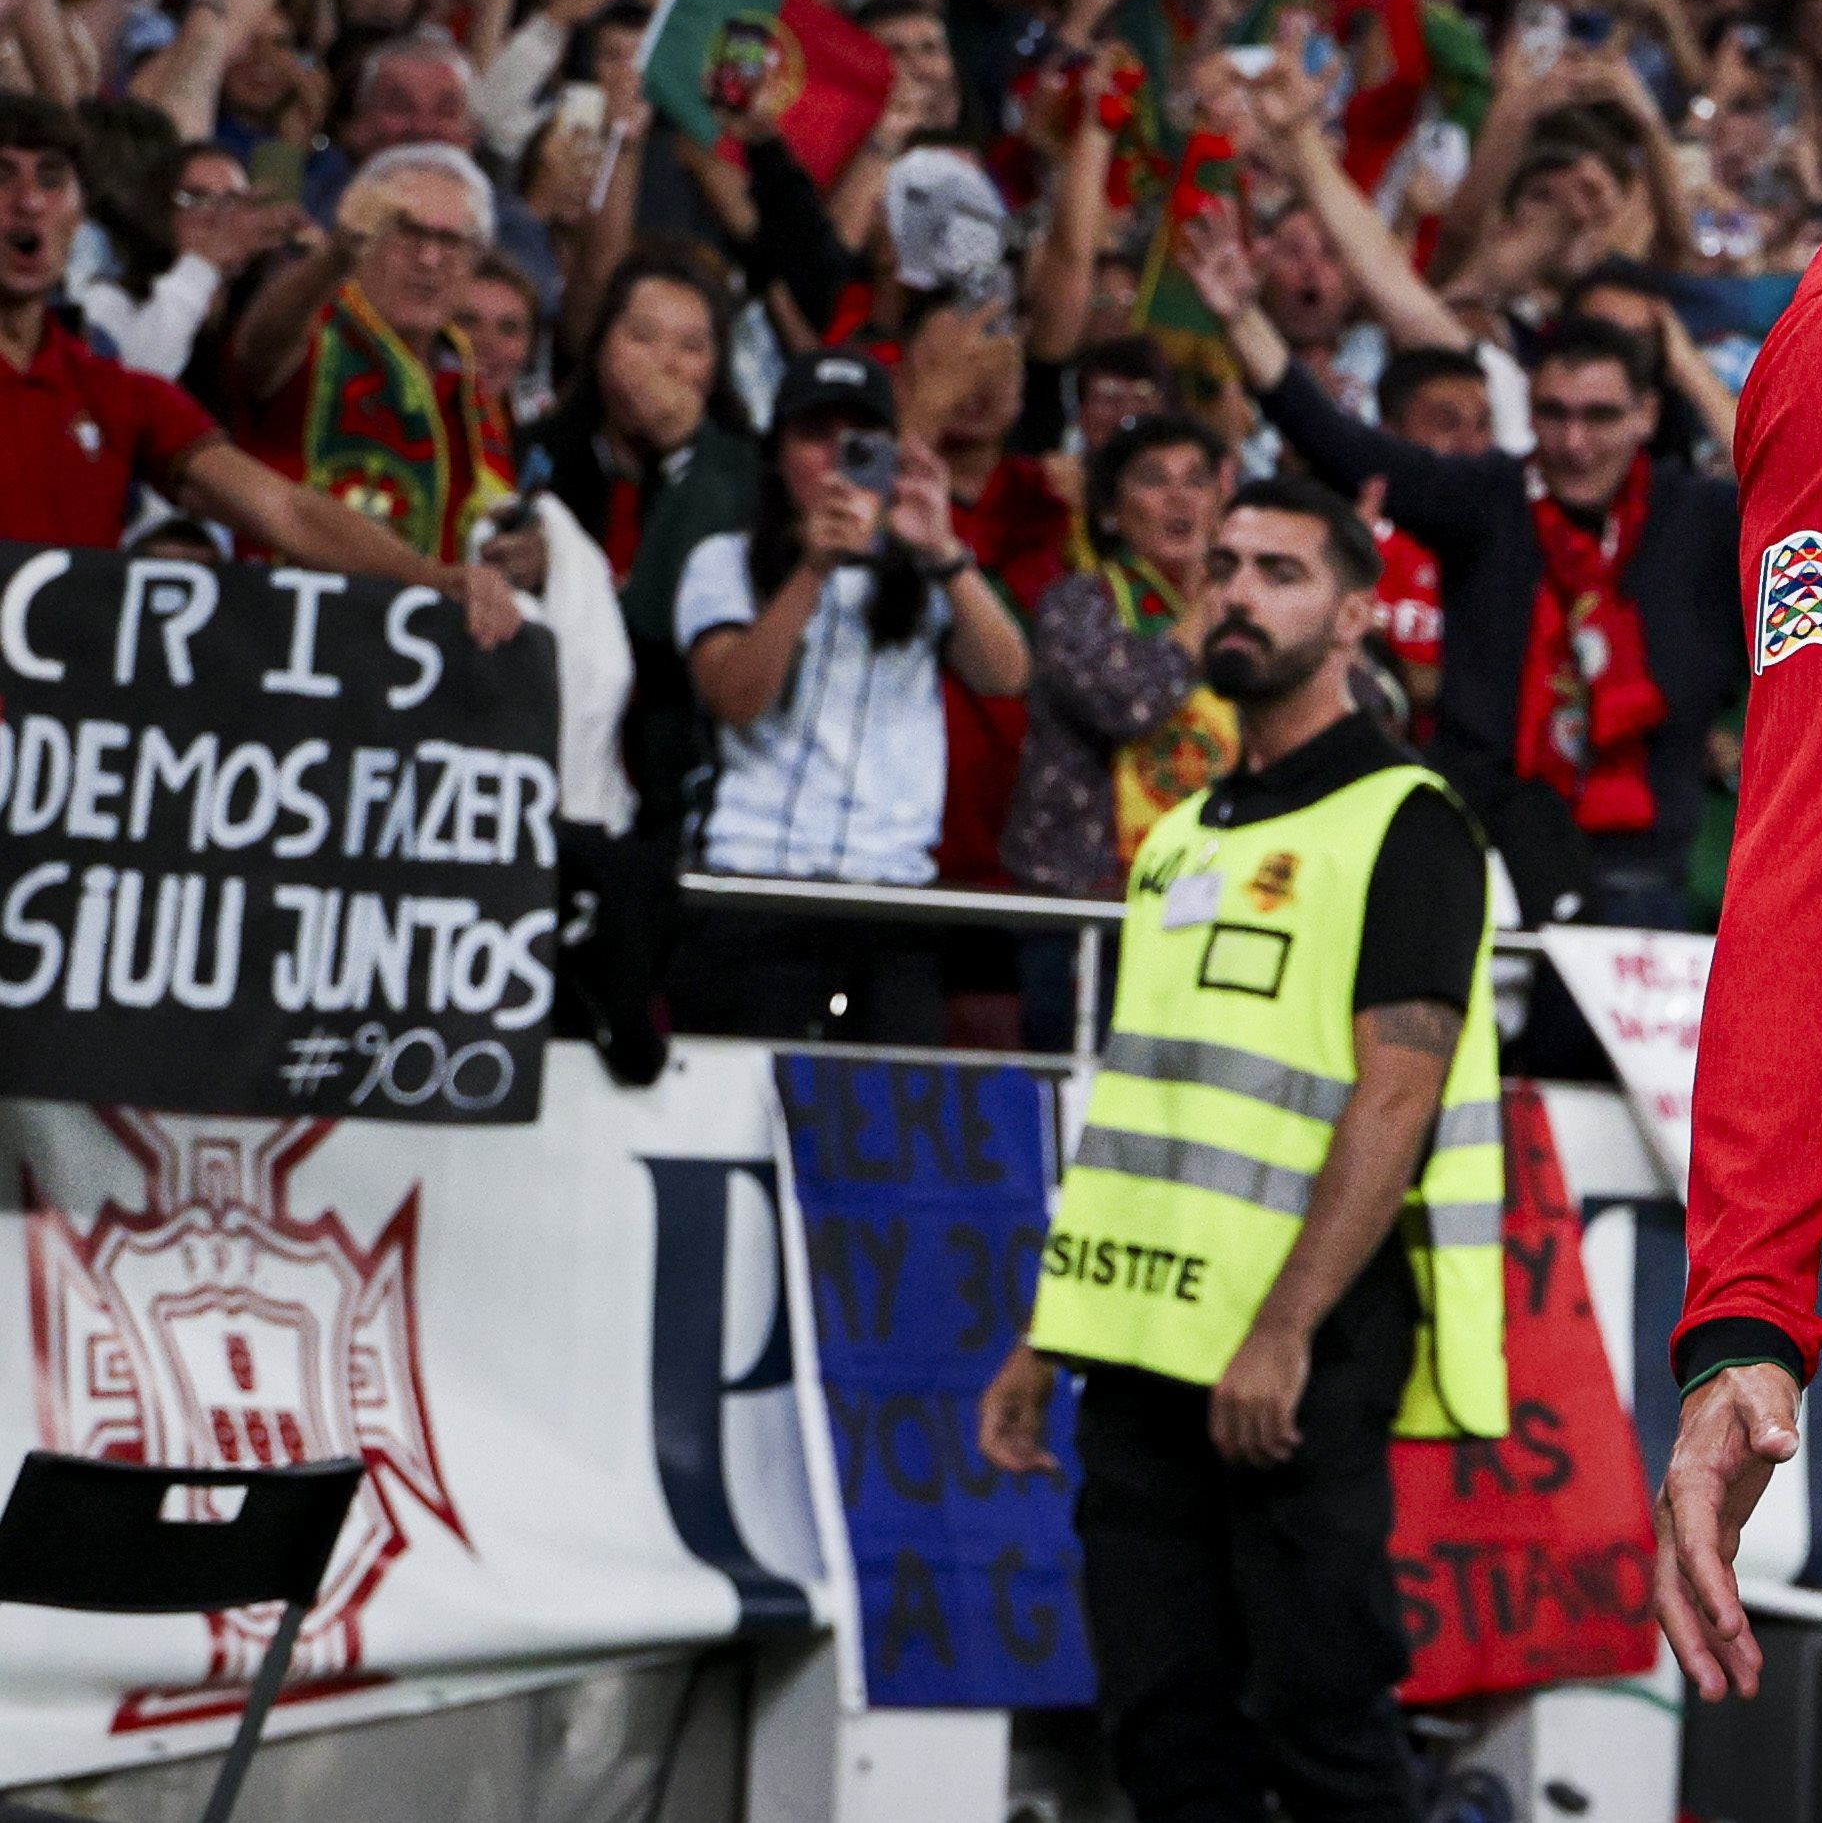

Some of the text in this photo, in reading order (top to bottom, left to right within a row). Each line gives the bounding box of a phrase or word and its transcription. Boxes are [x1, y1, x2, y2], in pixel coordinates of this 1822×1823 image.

[0, 714, 559, 867] DEMOS FAZER
[272, 884, 557, 1029] JUNTOS
[279, 1021, 515, 1110] #900
